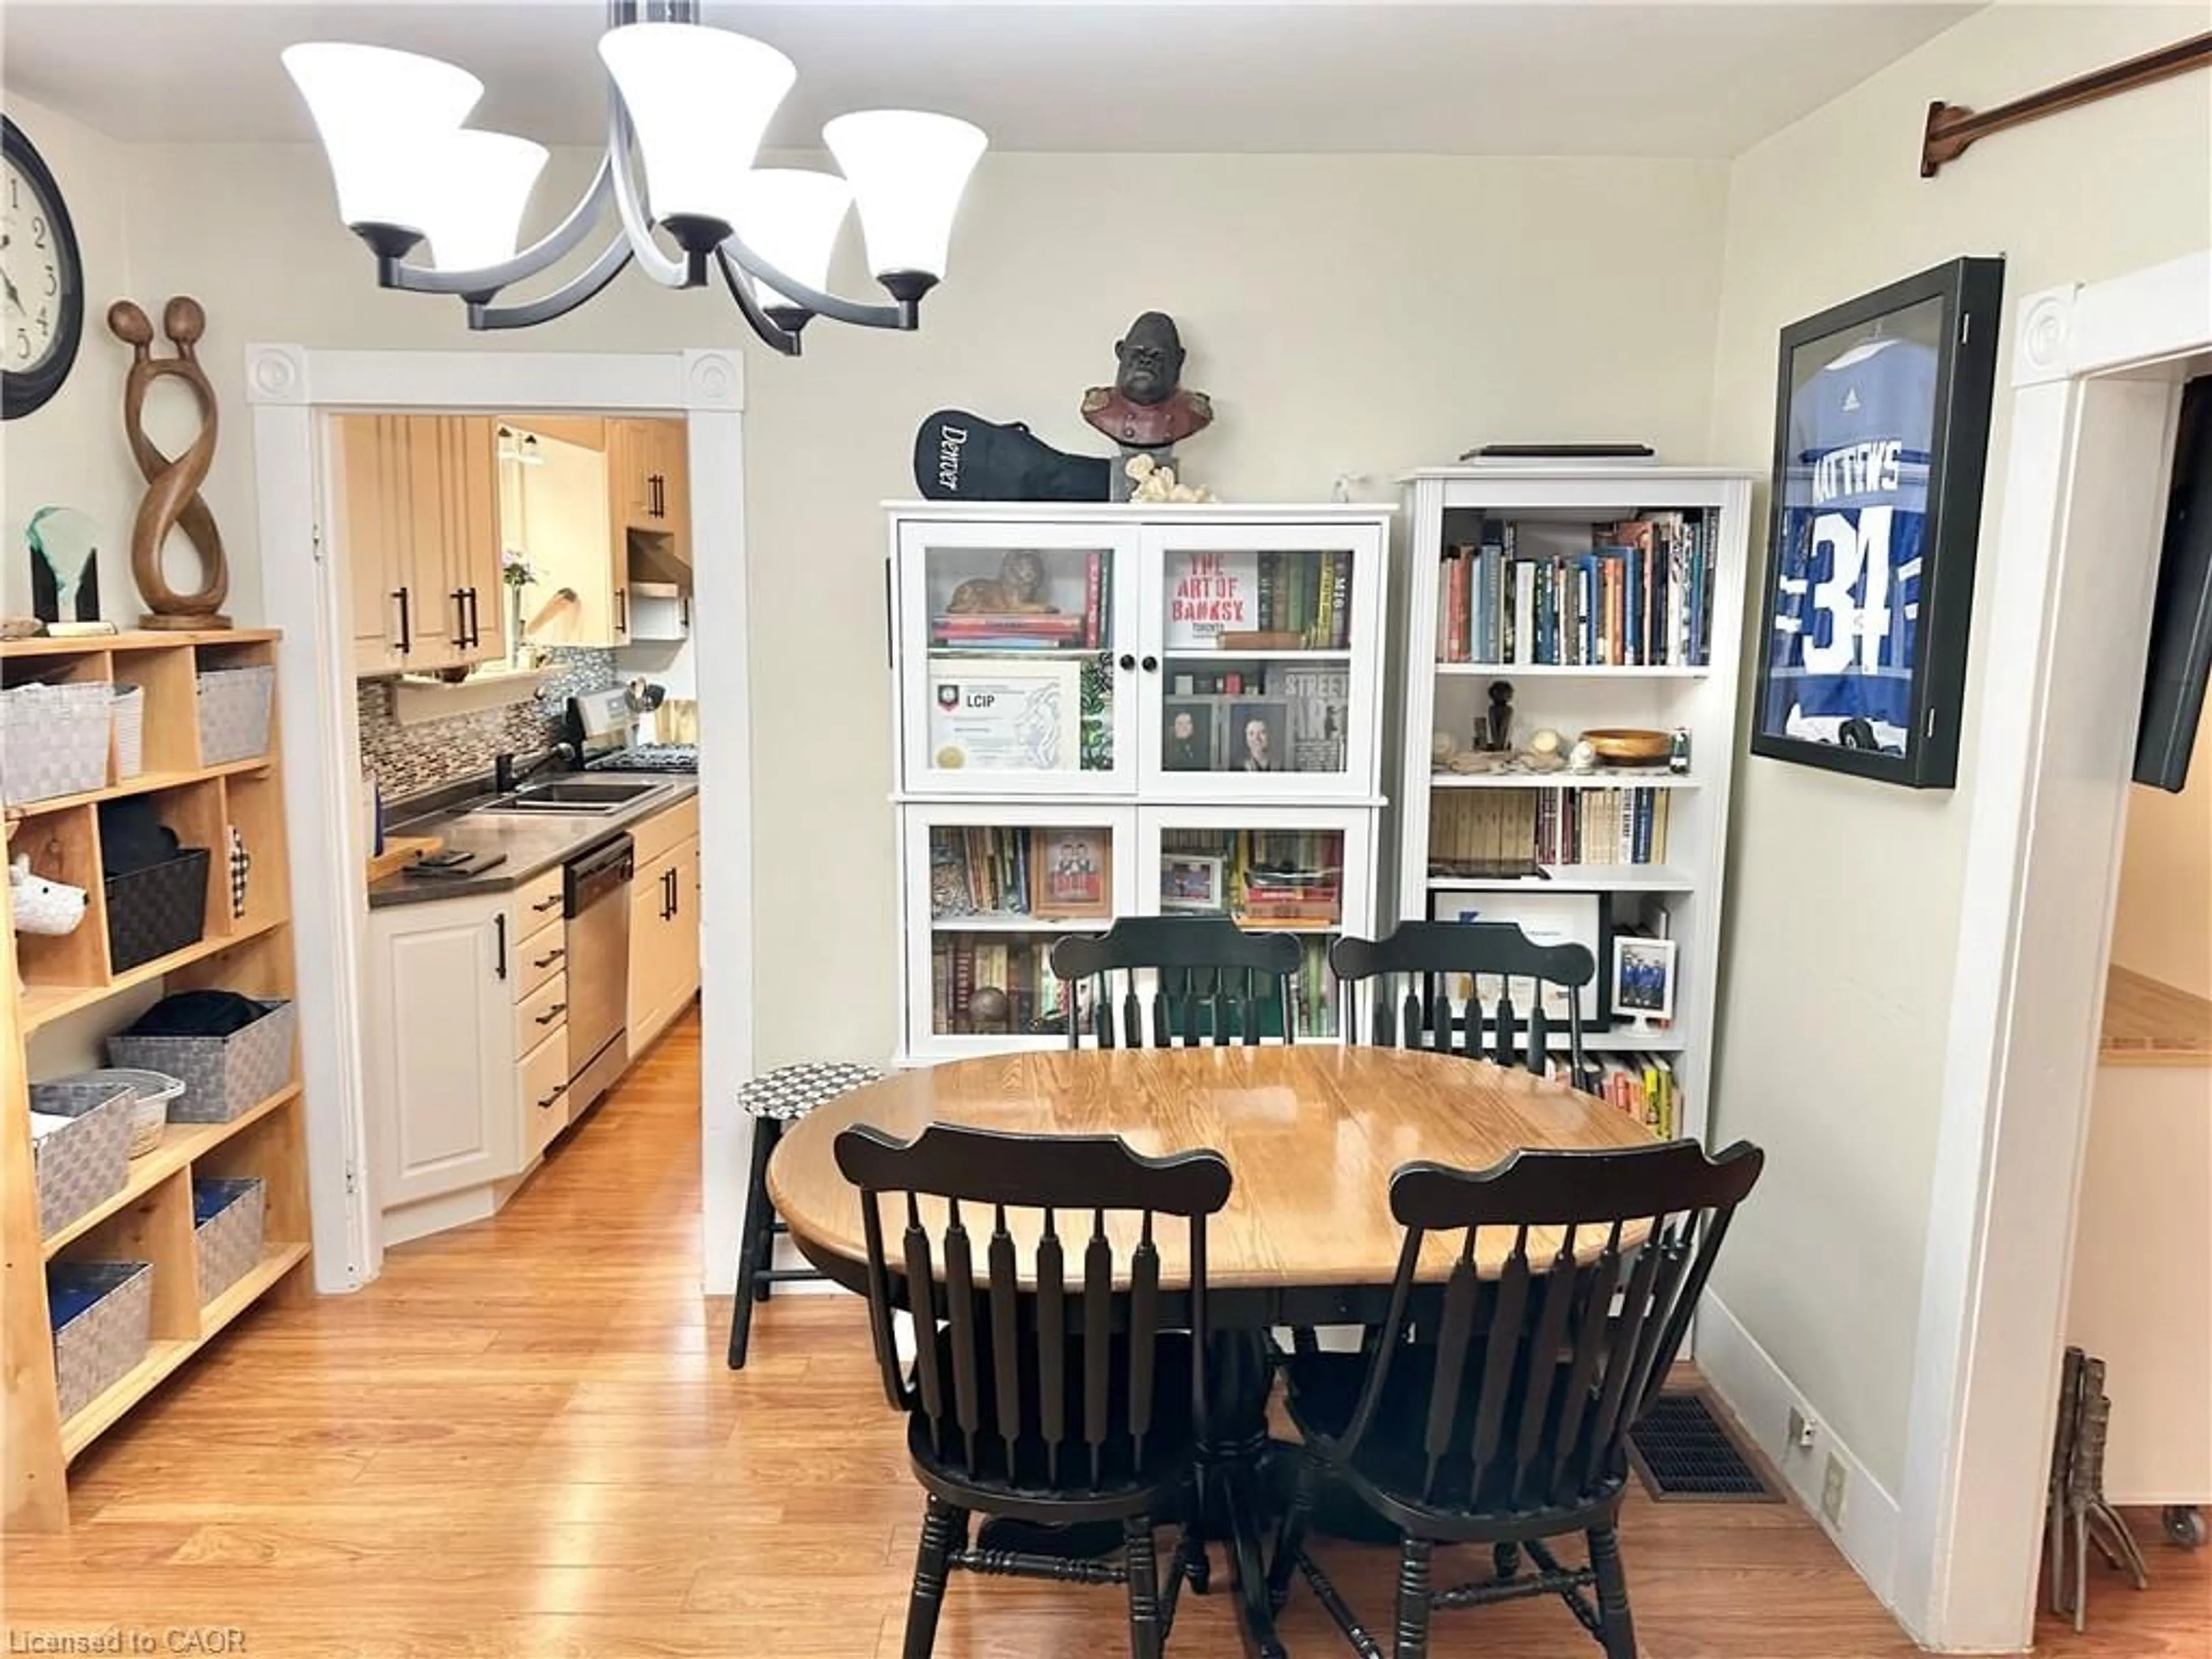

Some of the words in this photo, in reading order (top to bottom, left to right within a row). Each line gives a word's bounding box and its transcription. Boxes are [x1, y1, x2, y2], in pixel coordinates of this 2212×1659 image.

[32, 216, 46, 249] 2
[45, 264, 57, 297] 3
[17, 328, 31, 359] 5
[940, 425, 968, 491] Denver
[1191, 552, 1224, 575] THE
[1177, 577, 1213, 599] ART
[1216, 577, 1239, 598] OF
[1802, 505, 1893, 675] 34
[1172, 600, 1244, 622] BANKSY
